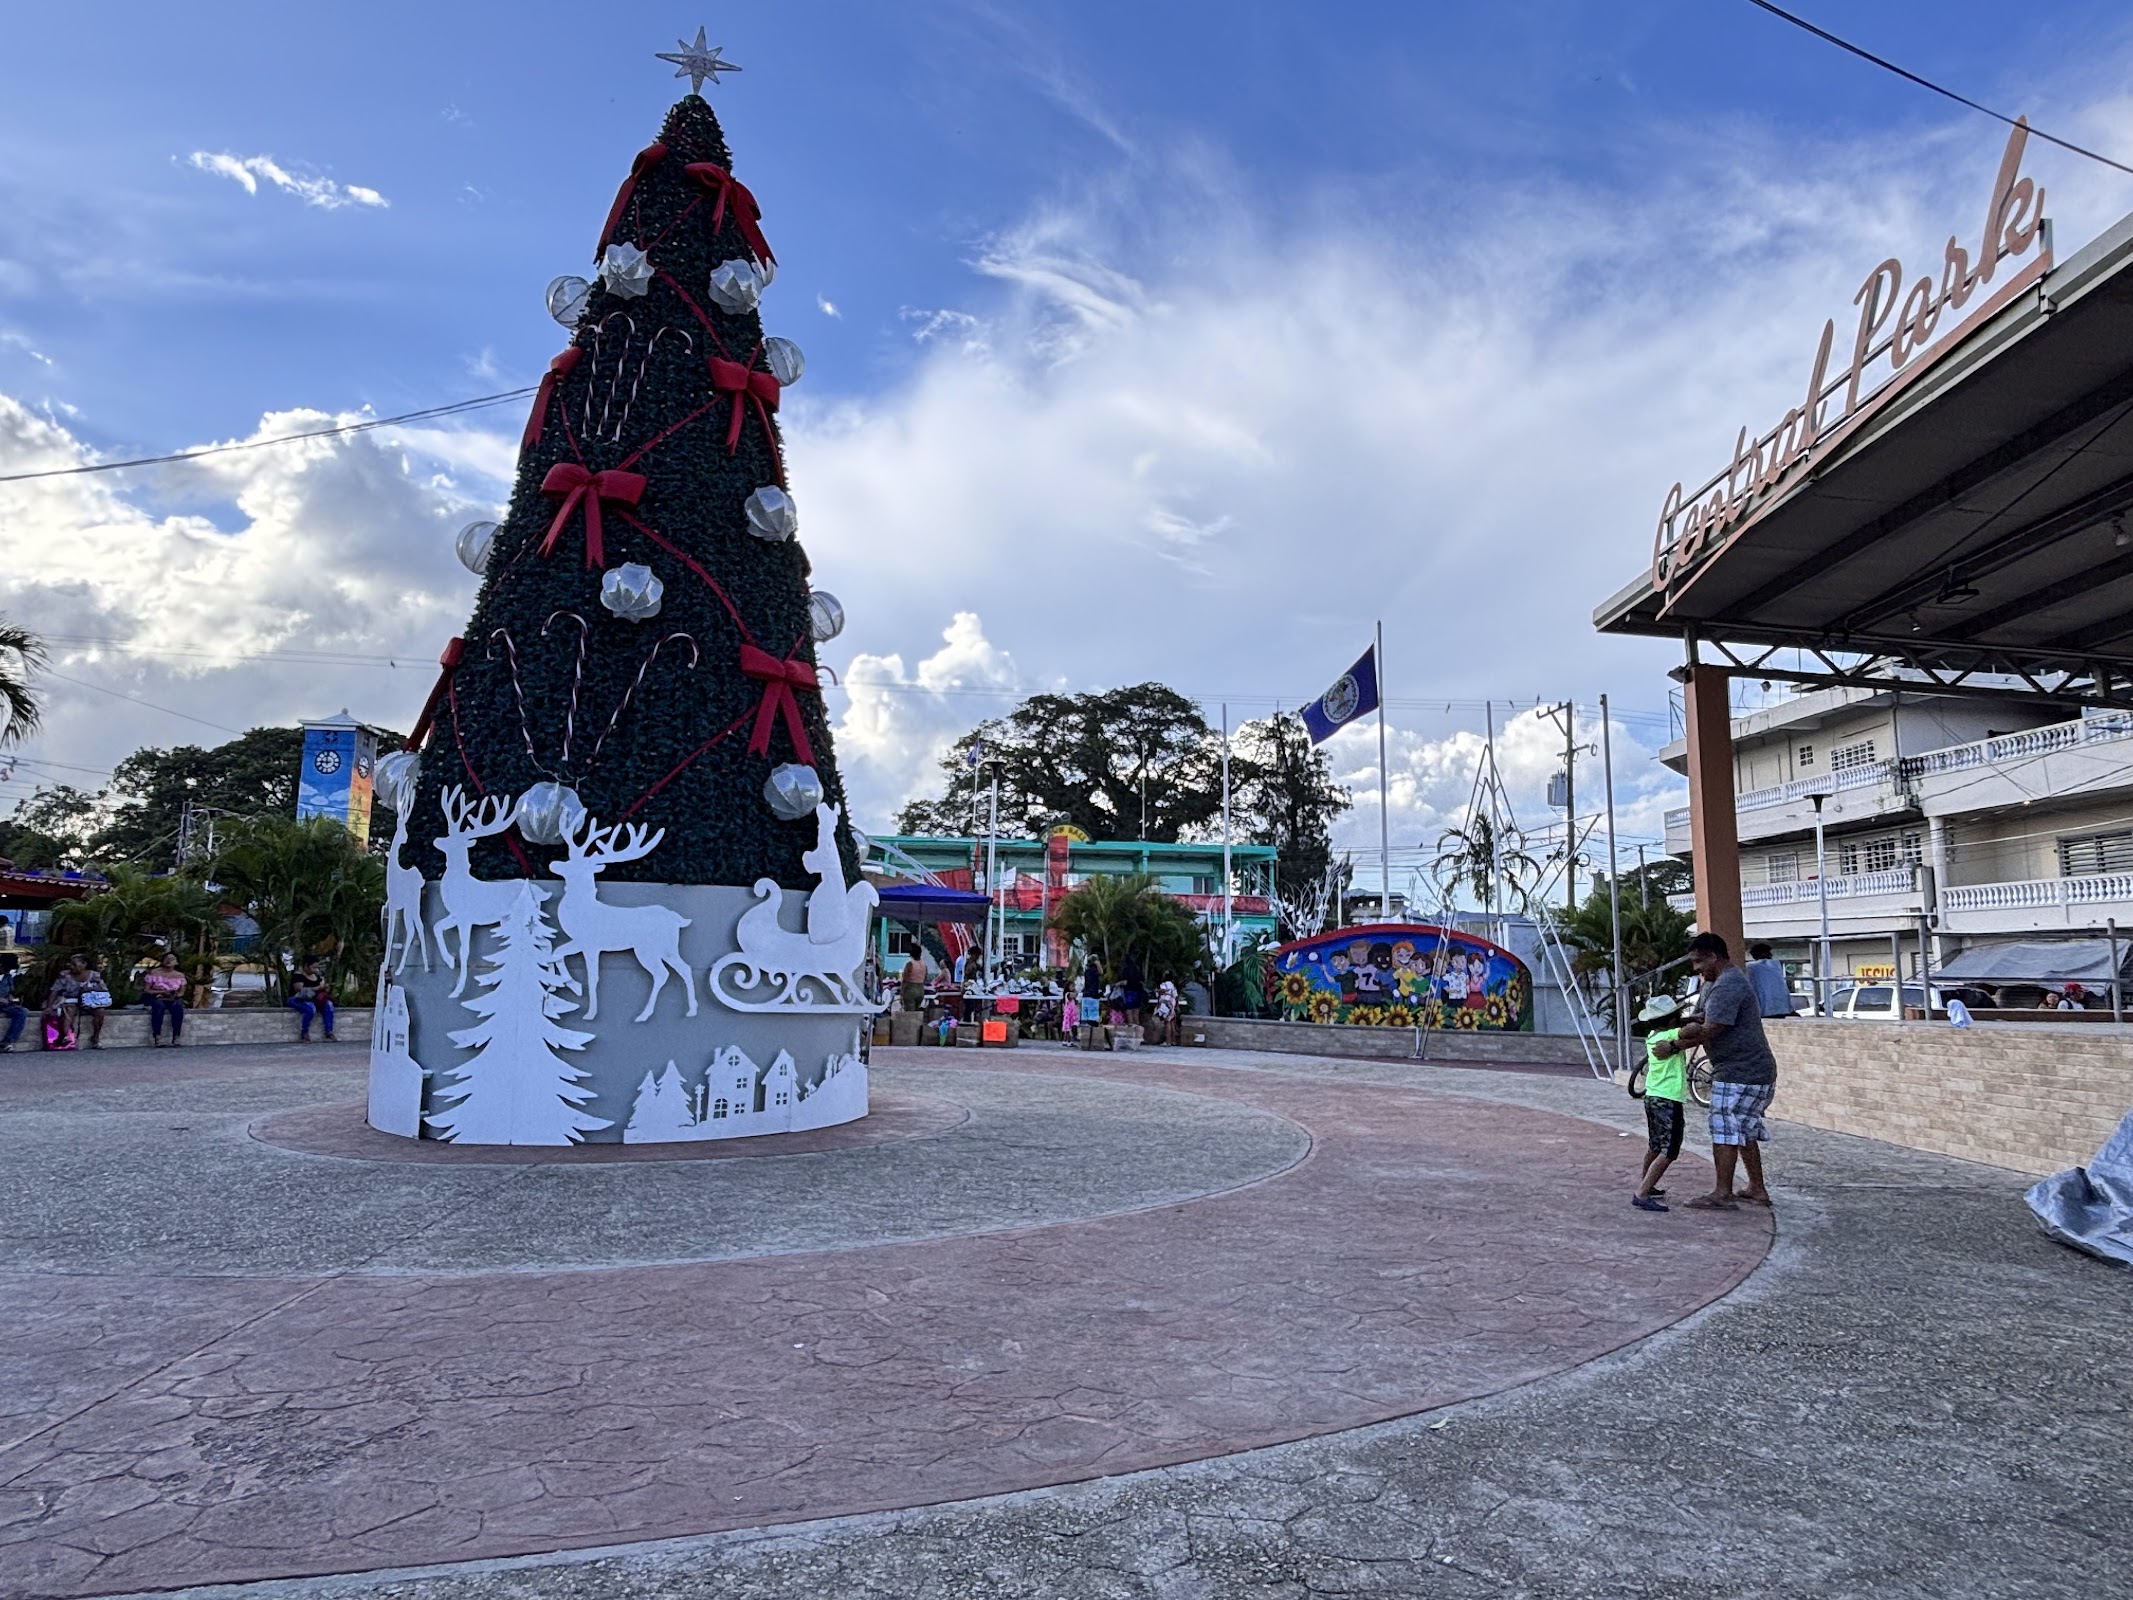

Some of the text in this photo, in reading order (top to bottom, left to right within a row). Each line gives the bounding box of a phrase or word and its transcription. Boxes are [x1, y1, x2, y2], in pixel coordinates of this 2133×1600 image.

[1652, 115, 2045, 592] Central Park
[1362, 972, 1373, 986] 7
